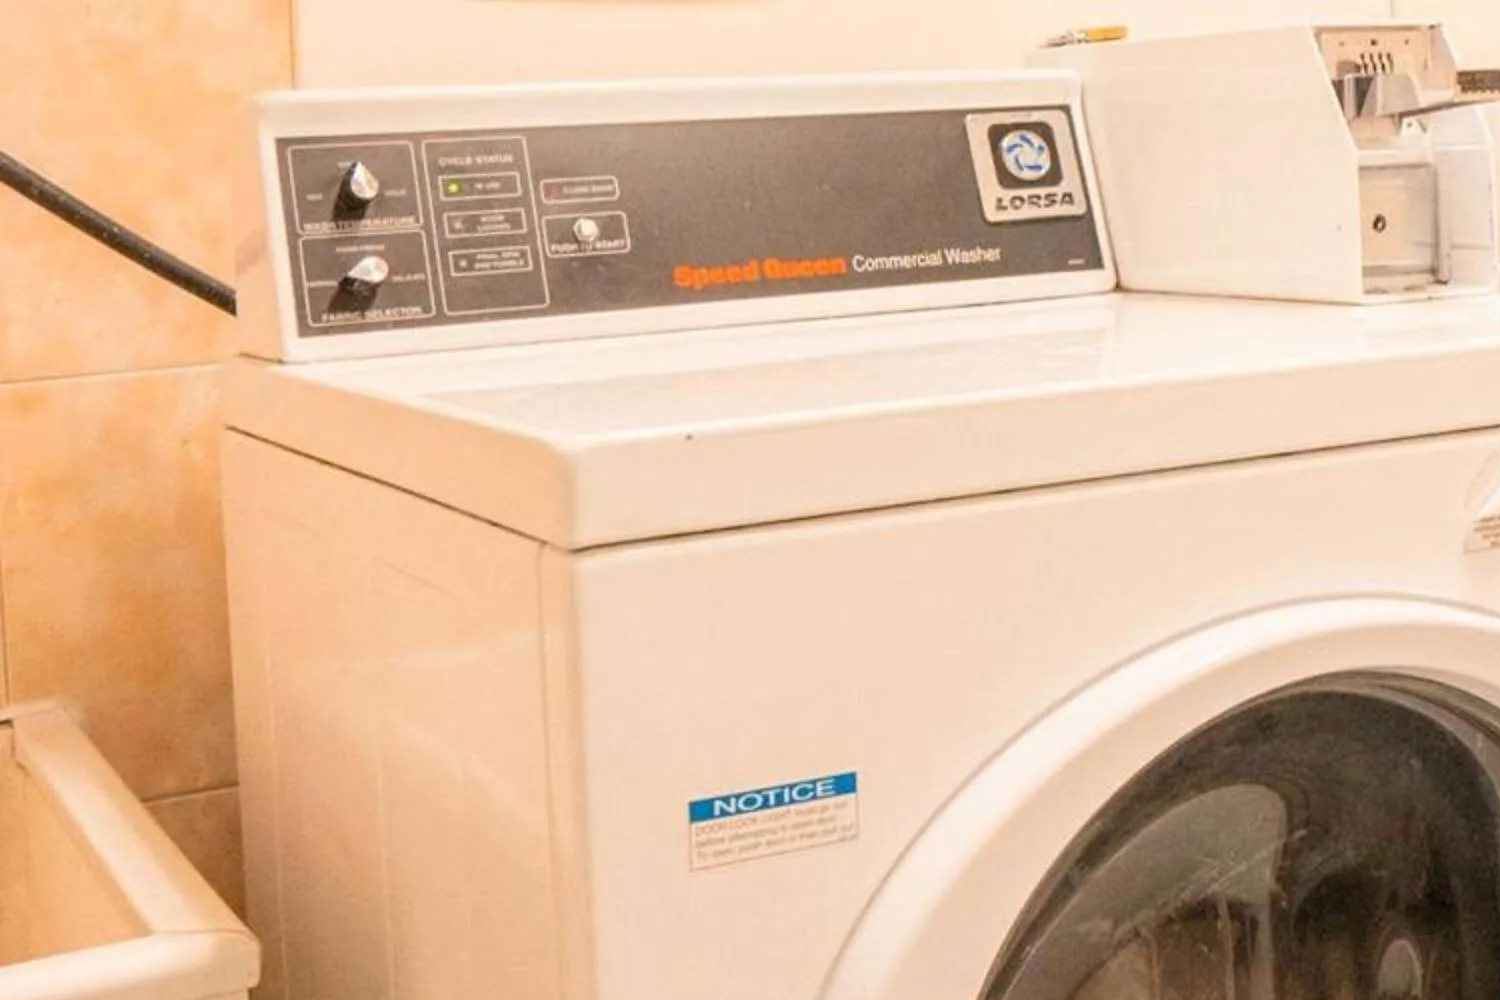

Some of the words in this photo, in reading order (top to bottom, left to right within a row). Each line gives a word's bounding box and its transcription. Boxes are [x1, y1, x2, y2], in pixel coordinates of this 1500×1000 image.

[995, 191, 1075, 212] LORSA
[672, 258, 760, 291] Speed
[763, 256, 847, 280] Queen
[852, 249, 943, 273] Commercial
[944, 245, 1002, 265] Washer
[713, 777, 837, 817] NOTICE
